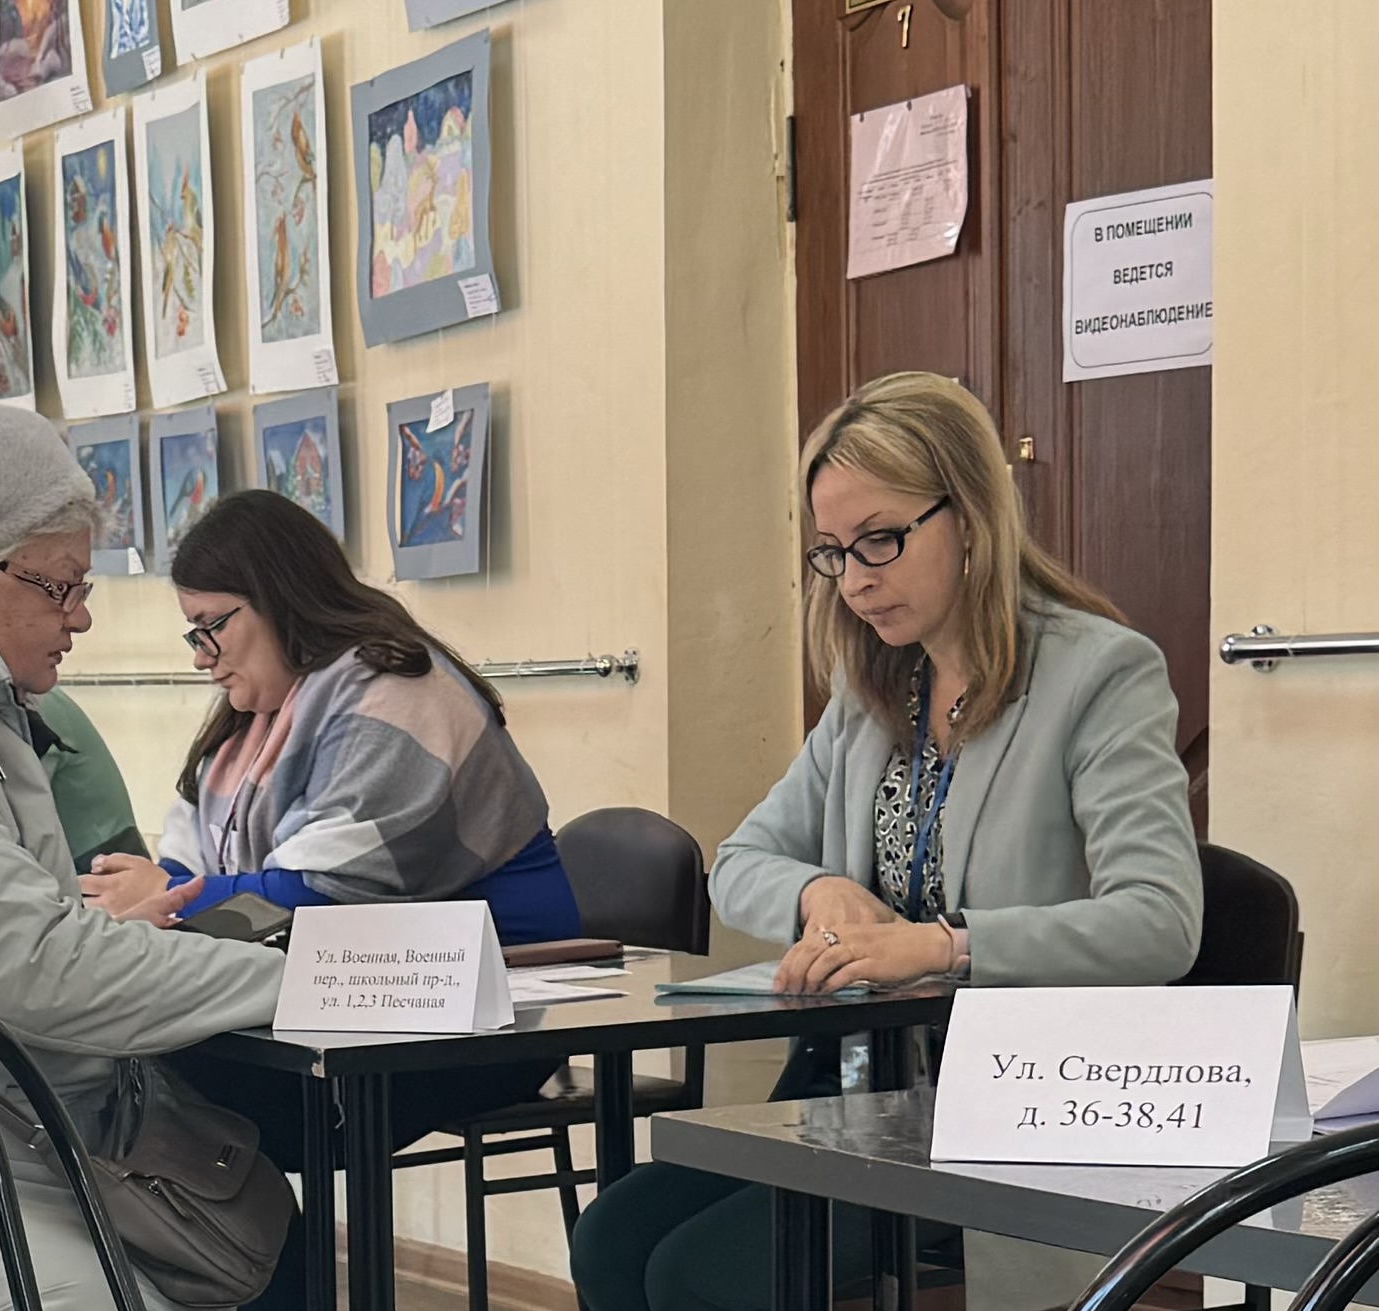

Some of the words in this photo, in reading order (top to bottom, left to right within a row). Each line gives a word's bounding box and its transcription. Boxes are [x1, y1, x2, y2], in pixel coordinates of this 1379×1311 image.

[1094, 227, 1104, 242] В
[1106, 212, 1193, 241] ПОМЕЩЕНИИ
[1113, 261, 1174, 285] ВЕДЕТСЯ
[1075, 302, 1213, 335] ВИДЕОНАБЛЮДЕНИЕ
[315, 950, 338, 964] Ул.
[342, 949, 400, 964] Военная,
[405, 948, 465, 963] Военный
[313, 974, 344, 989] пер.,
[348, 972, 418, 986] школьный
[422, 974, 460, 989] пр-д.,
[320, 996, 340, 1010] ул.
[346, 994, 377, 1009] 1,2,3
[381, 994, 445, 1009] Песчаная
[992, 1054, 1044, 1080] Ул.
[1058, 1055, 1252, 1090] Свердлова,
[1017, 1106, 1046, 1130] д.
[1059, 1100, 1204, 1133] 36-38,41
